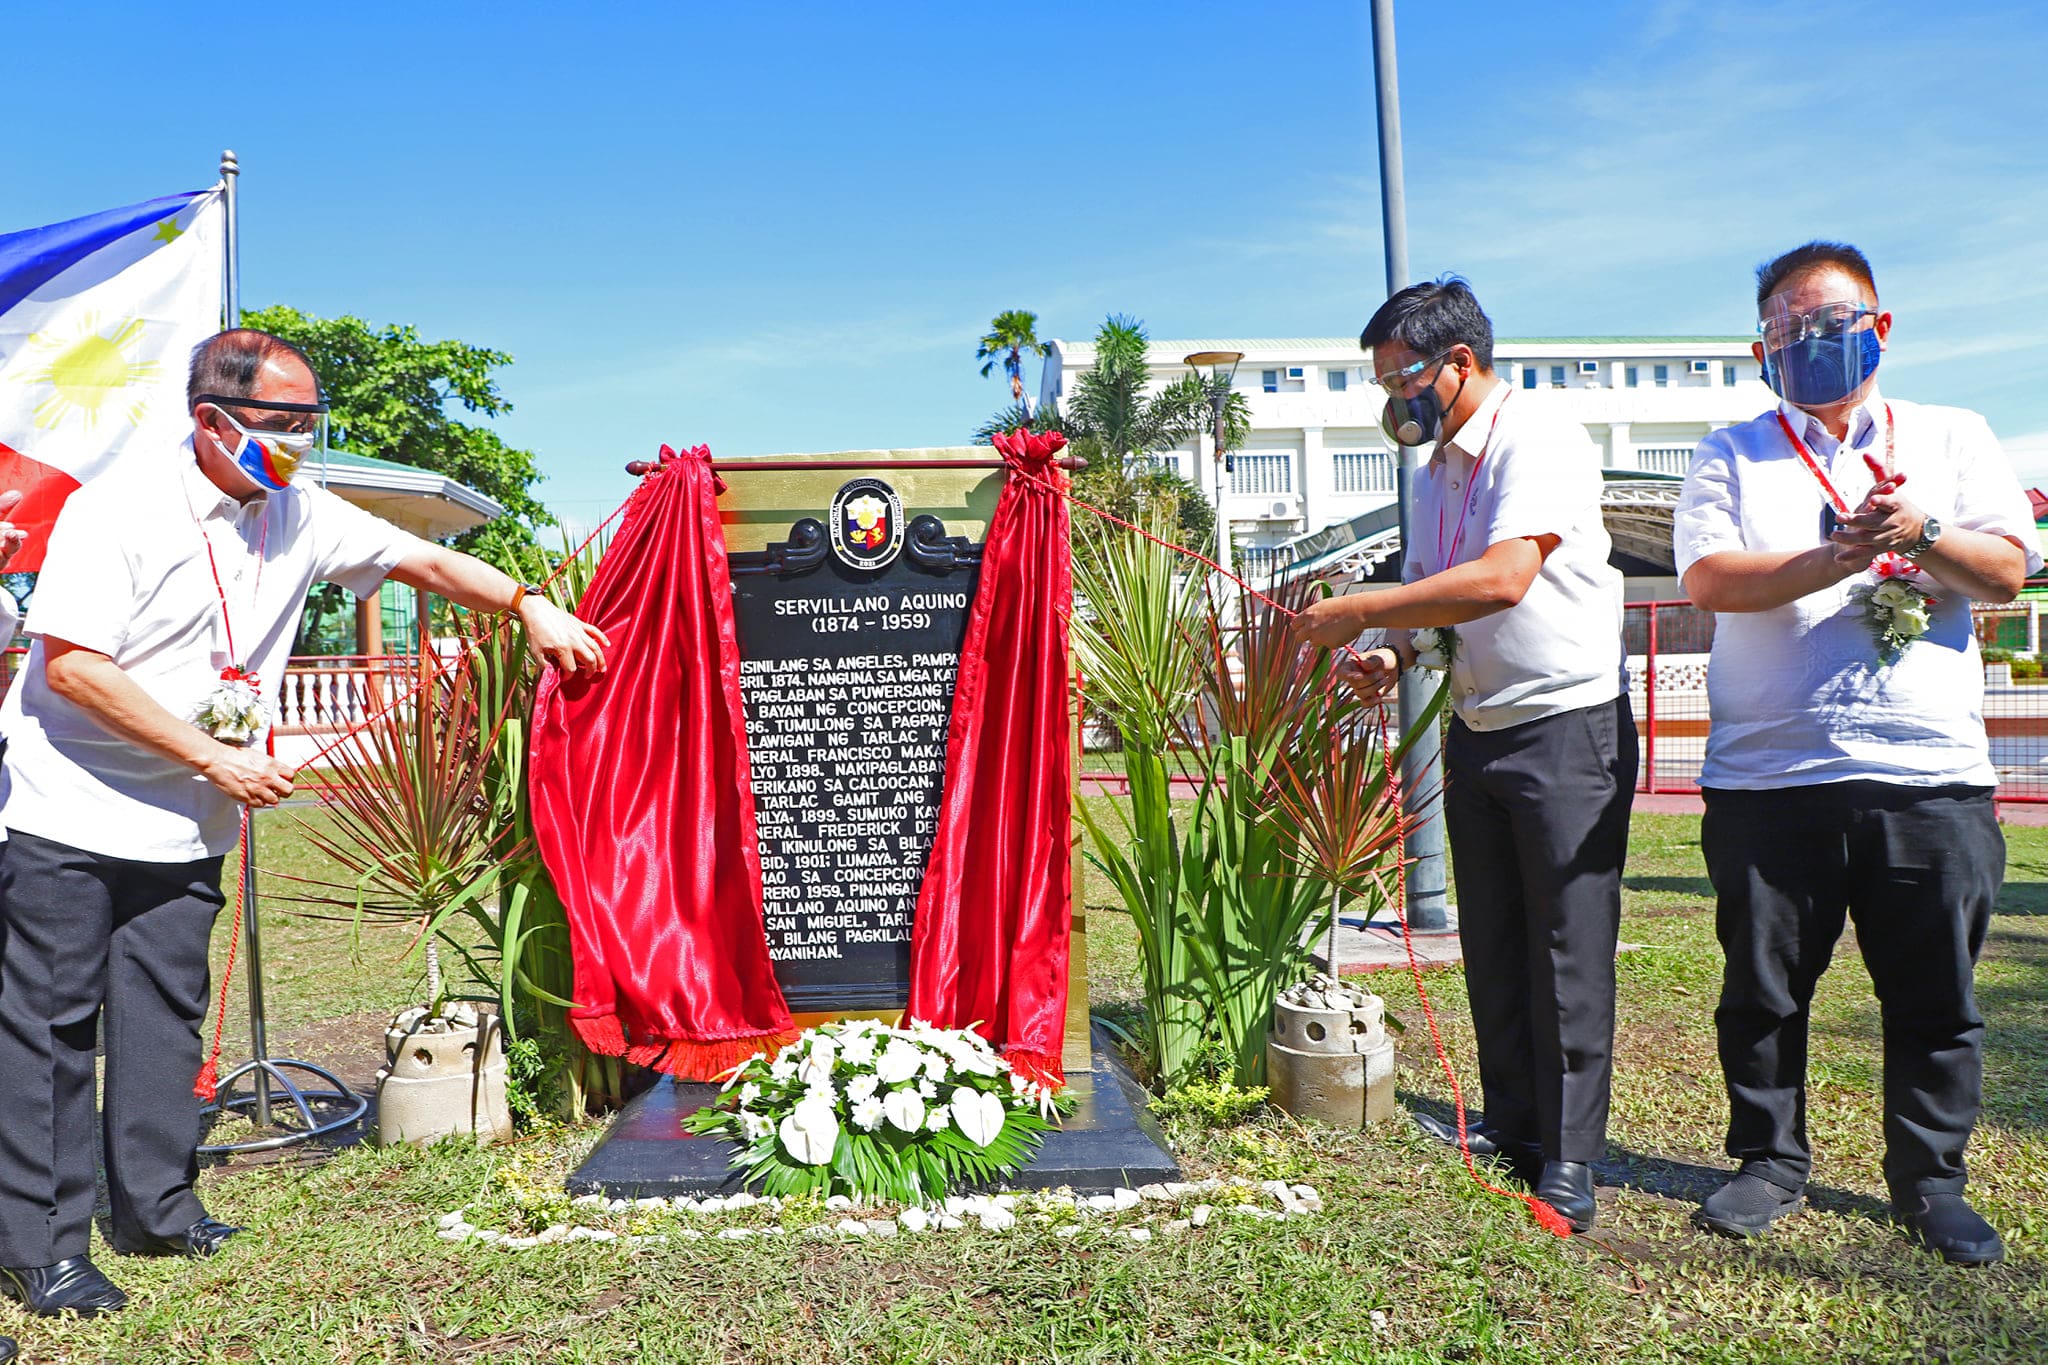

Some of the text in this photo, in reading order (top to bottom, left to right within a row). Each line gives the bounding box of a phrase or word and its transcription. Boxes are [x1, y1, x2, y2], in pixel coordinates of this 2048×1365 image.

[842, 480, 883, 494] HISTORICAL
[775, 593, 966, 615] SERVILLANO AQUINO
[812, 617, 859, 632] (1874
[882, 613, 930, 630] 1959)
[740, 653, 959, 674] ISINILANG SA ANGELES, PAMPA
[738, 668, 957, 688] BRIL 1874. NANGUNA SA MGA KAT
[751, 688, 825, 704] PAGLABAN
[829, 687, 848, 701] SA
[852, 683, 942, 700] PUWERSANG
[759, 704, 804, 718] BAYAN
[816, 703, 836, 716] NG
[847, 699, 945, 715] CONCEPCION,
[745, 720, 769, 734] 96.
[775, 717, 855, 733] TUMULONG
[864, 716, 883, 729] SA
[746, 729, 948, 748] LAWIGAN NG TARLAC KA
[747, 749, 799, 764] NERAL
[808, 746, 892, 762] FRANCISCO
[751, 765, 776, 779] LYO
[786, 764, 825, 778] 1898.
[824, 778, 844, 792] SA
[849, 775, 934, 790] CALOOCAN,
[761, 790, 924, 809] TARLAC GAMIT ANG
[754, 811, 794, 824] RILYA,
[801, 809, 840, 823] 1899.
[847, 806, 907, 821] SUMUKO
[755, 825, 803, 839] NERAL
[818, 821, 900, 838] FREDERICK
[782, 838, 857, 854] IKINULONG
[868, 837, 888, 851] SA
[760, 851, 922, 869] BID, 1901; LUMAYA, 25
[801, 870, 821, 883] SA
[834, 867, 924, 882] CONCEPCION
[763, 882, 919, 900] RERO 1959. PINANGAL
[761, 897, 916, 915] VILLANO AQUINO AN
[767, 913, 913, 930] SAN MIGUEL, TARL
[784, 931, 837, 945] BILANG
[846, 929, 912, 943] PAGKILAL
[769, 945, 842, 961] AYANIHAN.
